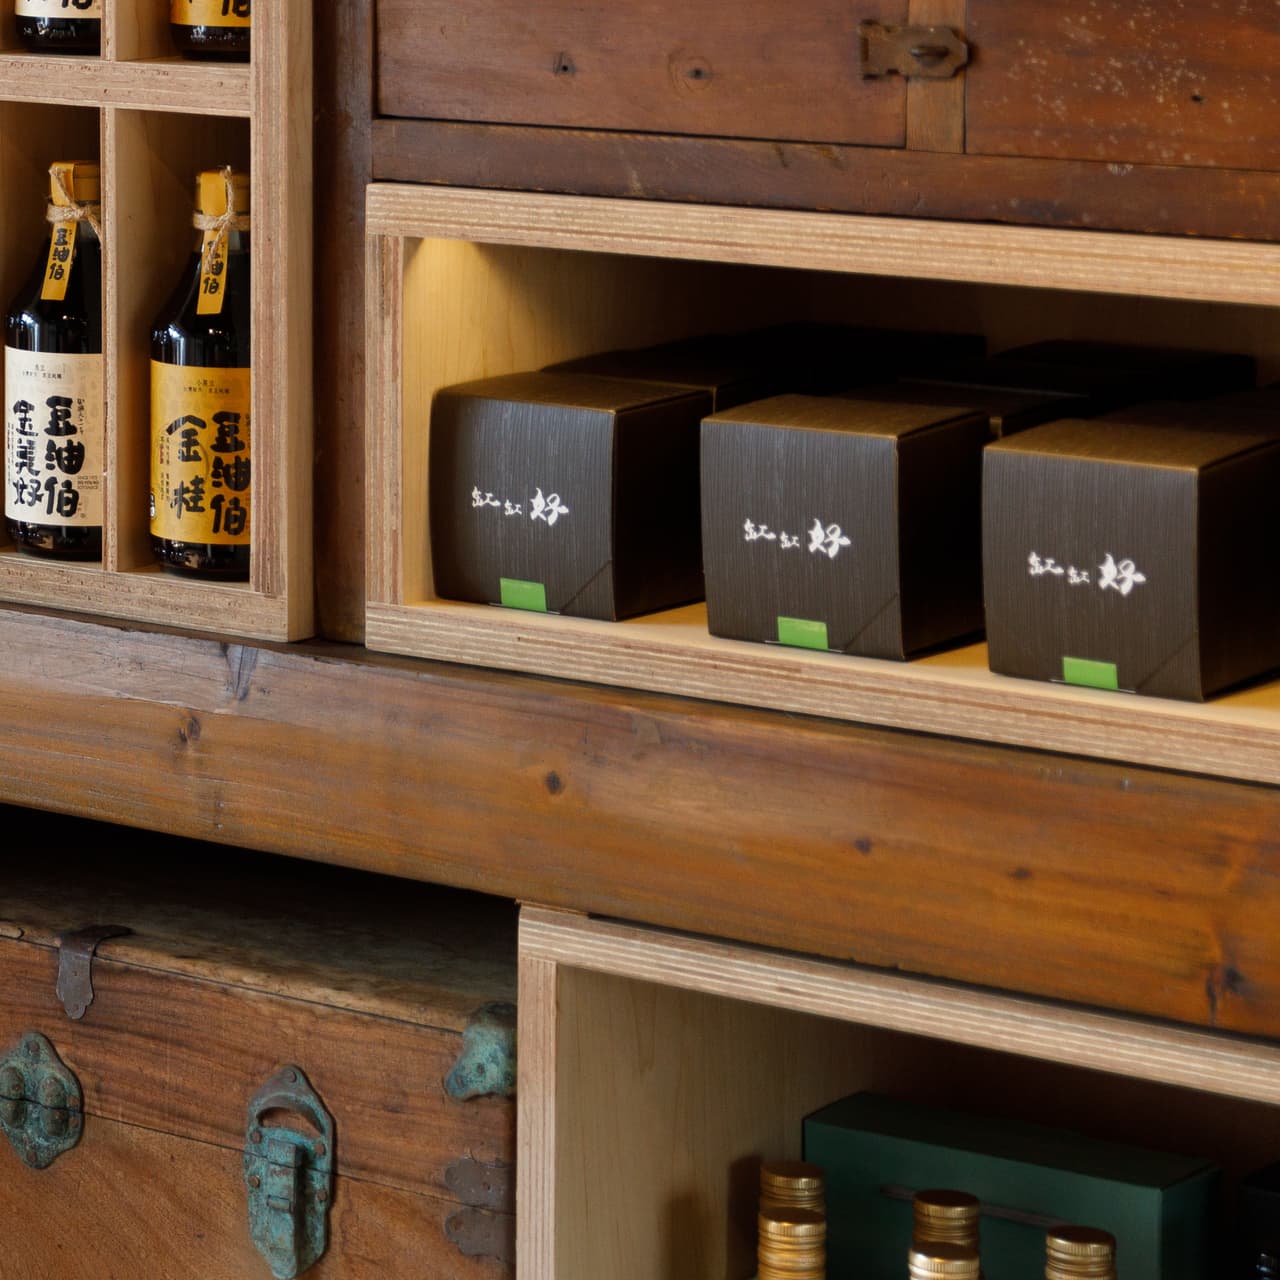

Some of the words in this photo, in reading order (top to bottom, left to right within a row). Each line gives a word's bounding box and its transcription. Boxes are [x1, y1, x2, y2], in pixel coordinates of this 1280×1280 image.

[49, 227, 68, 281] 豆油伯
[44, 395, 85, 518] 豆油伯
[210, 411, 251, 536] 豆油伯
